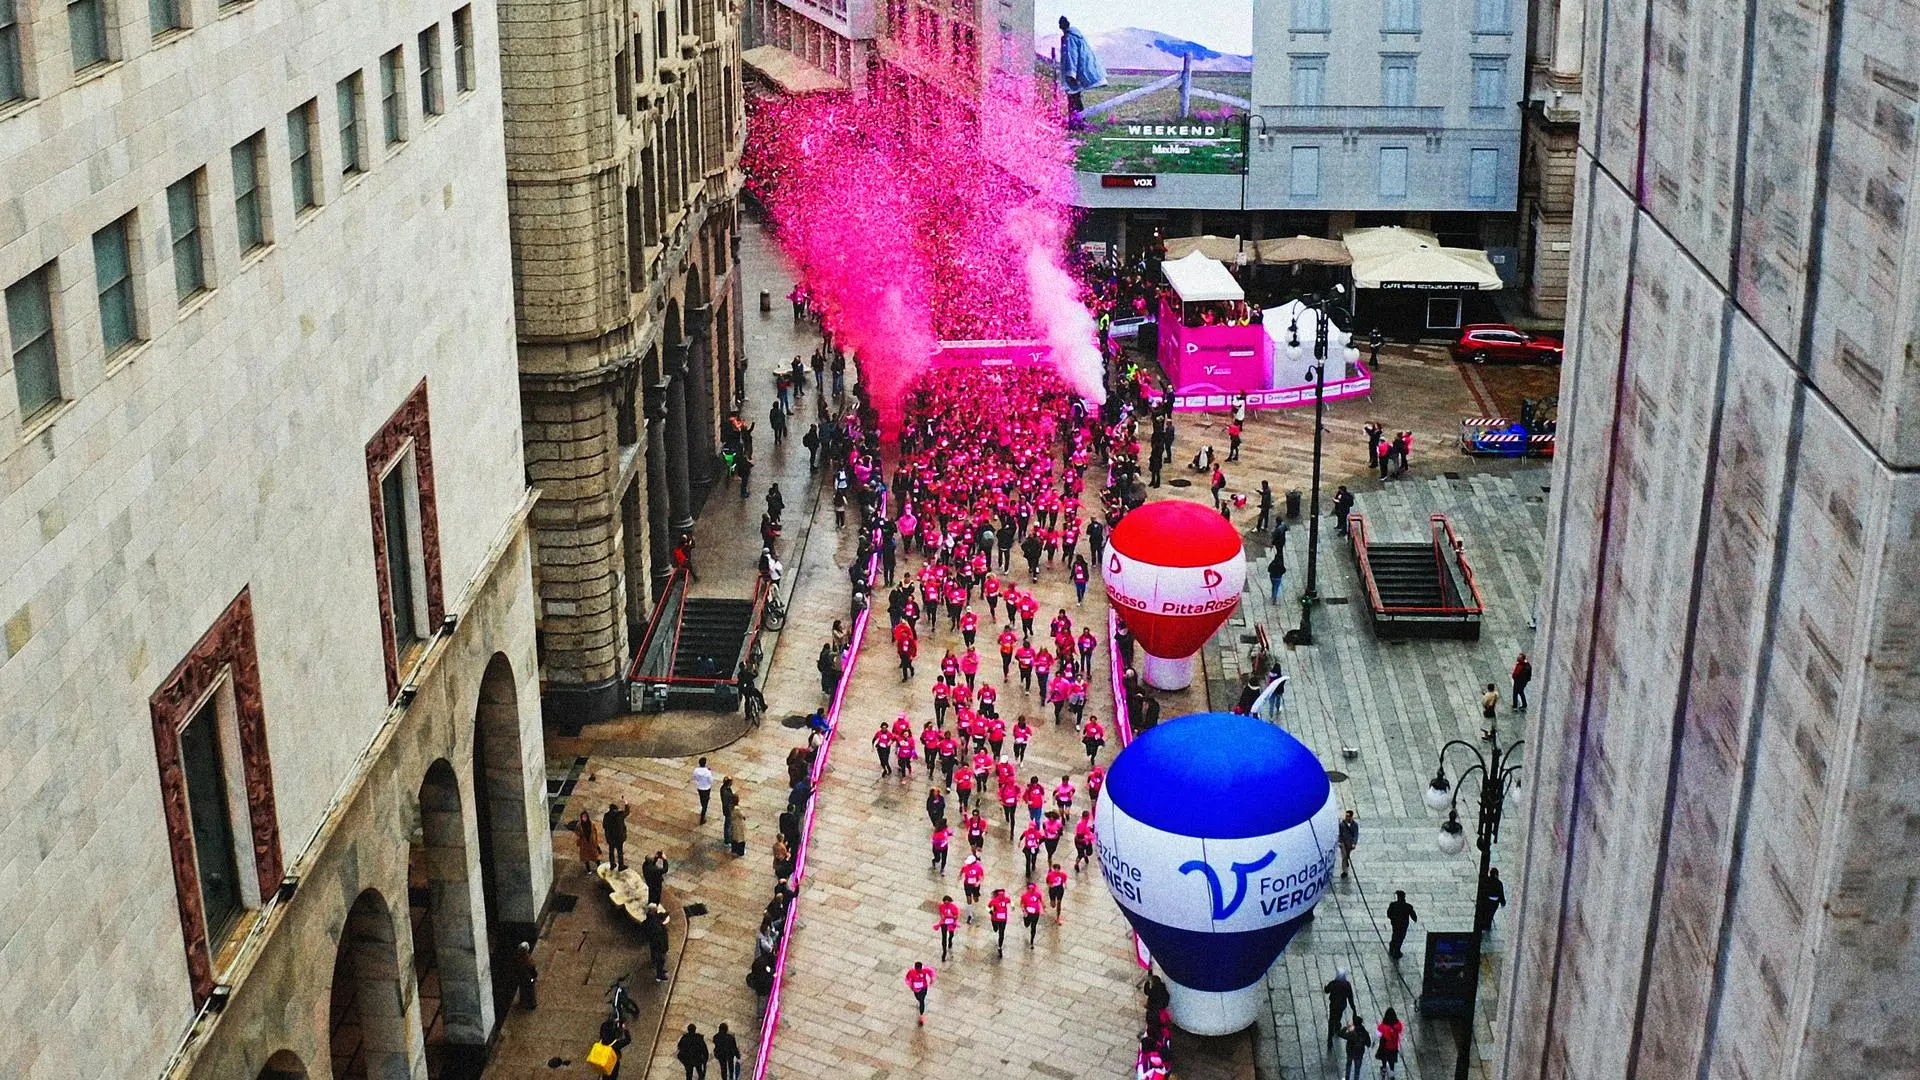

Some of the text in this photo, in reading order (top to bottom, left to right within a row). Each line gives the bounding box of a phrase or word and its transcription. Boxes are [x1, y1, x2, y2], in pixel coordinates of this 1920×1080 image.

[1128, 125, 1216, 136] WEEKEND
[1151, 144, 1190, 154] MaxMara
[1107, 585, 1147, 609] Rosso
[1260, 871, 1330, 916] VERON
